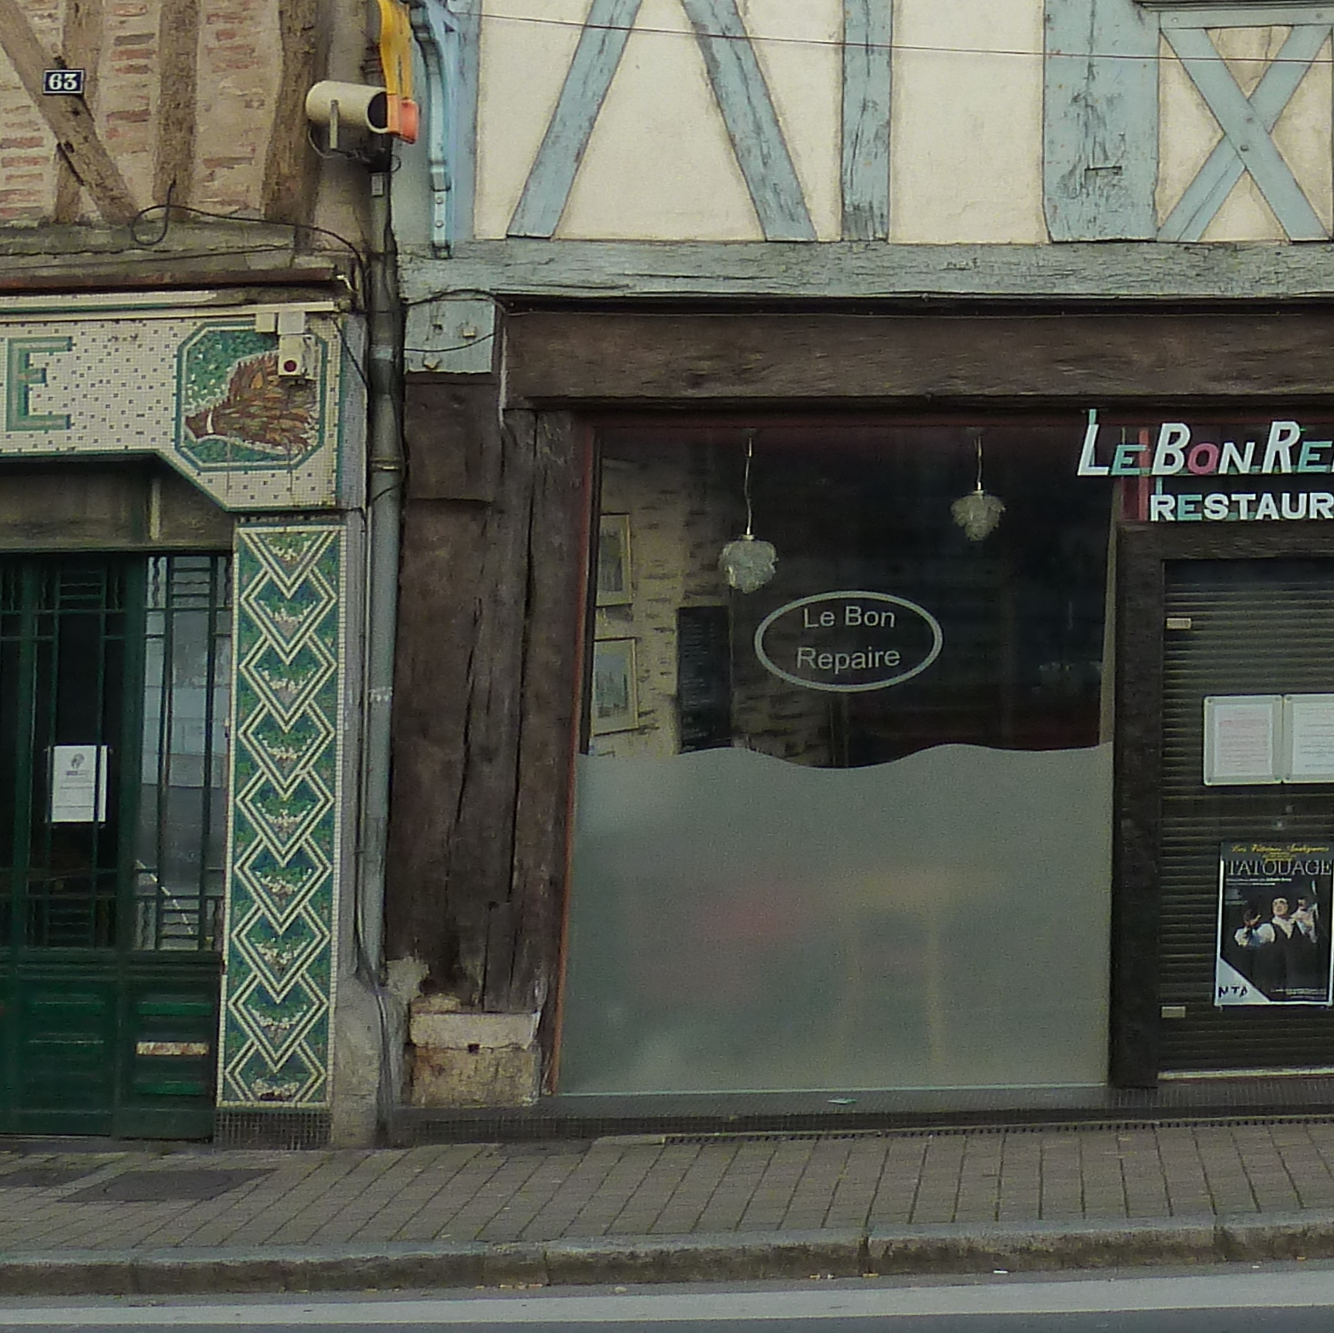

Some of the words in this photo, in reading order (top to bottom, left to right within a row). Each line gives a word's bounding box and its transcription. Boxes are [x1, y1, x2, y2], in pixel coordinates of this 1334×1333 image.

[49, 73, 77, 90] 63
[1077, 424, 1147, 476] LE
[1151, 422, 1255, 475] BON
[803, 608, 835, 628] Le
[845, 605, 896, 628] Bon
[796, 646, 901, 675] Repaire
